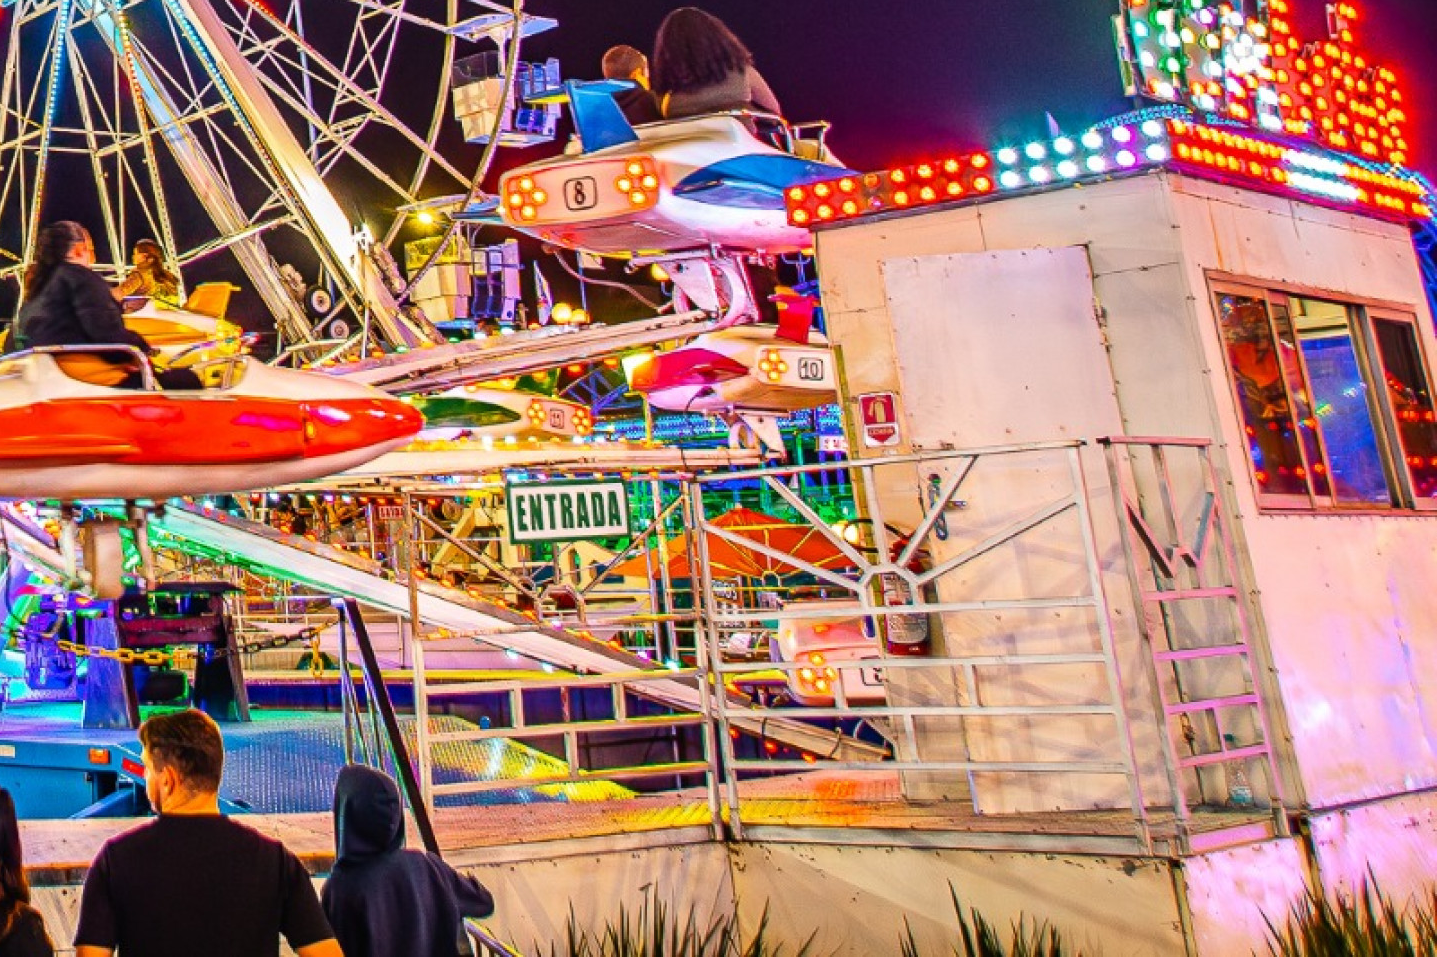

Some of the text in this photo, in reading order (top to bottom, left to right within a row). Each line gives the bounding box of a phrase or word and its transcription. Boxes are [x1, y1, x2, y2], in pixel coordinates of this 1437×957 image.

[574, 180, 586, 206] 8
[801, 360, 819, 378] 10
[515, 490, 622, 532] ENTRADA
